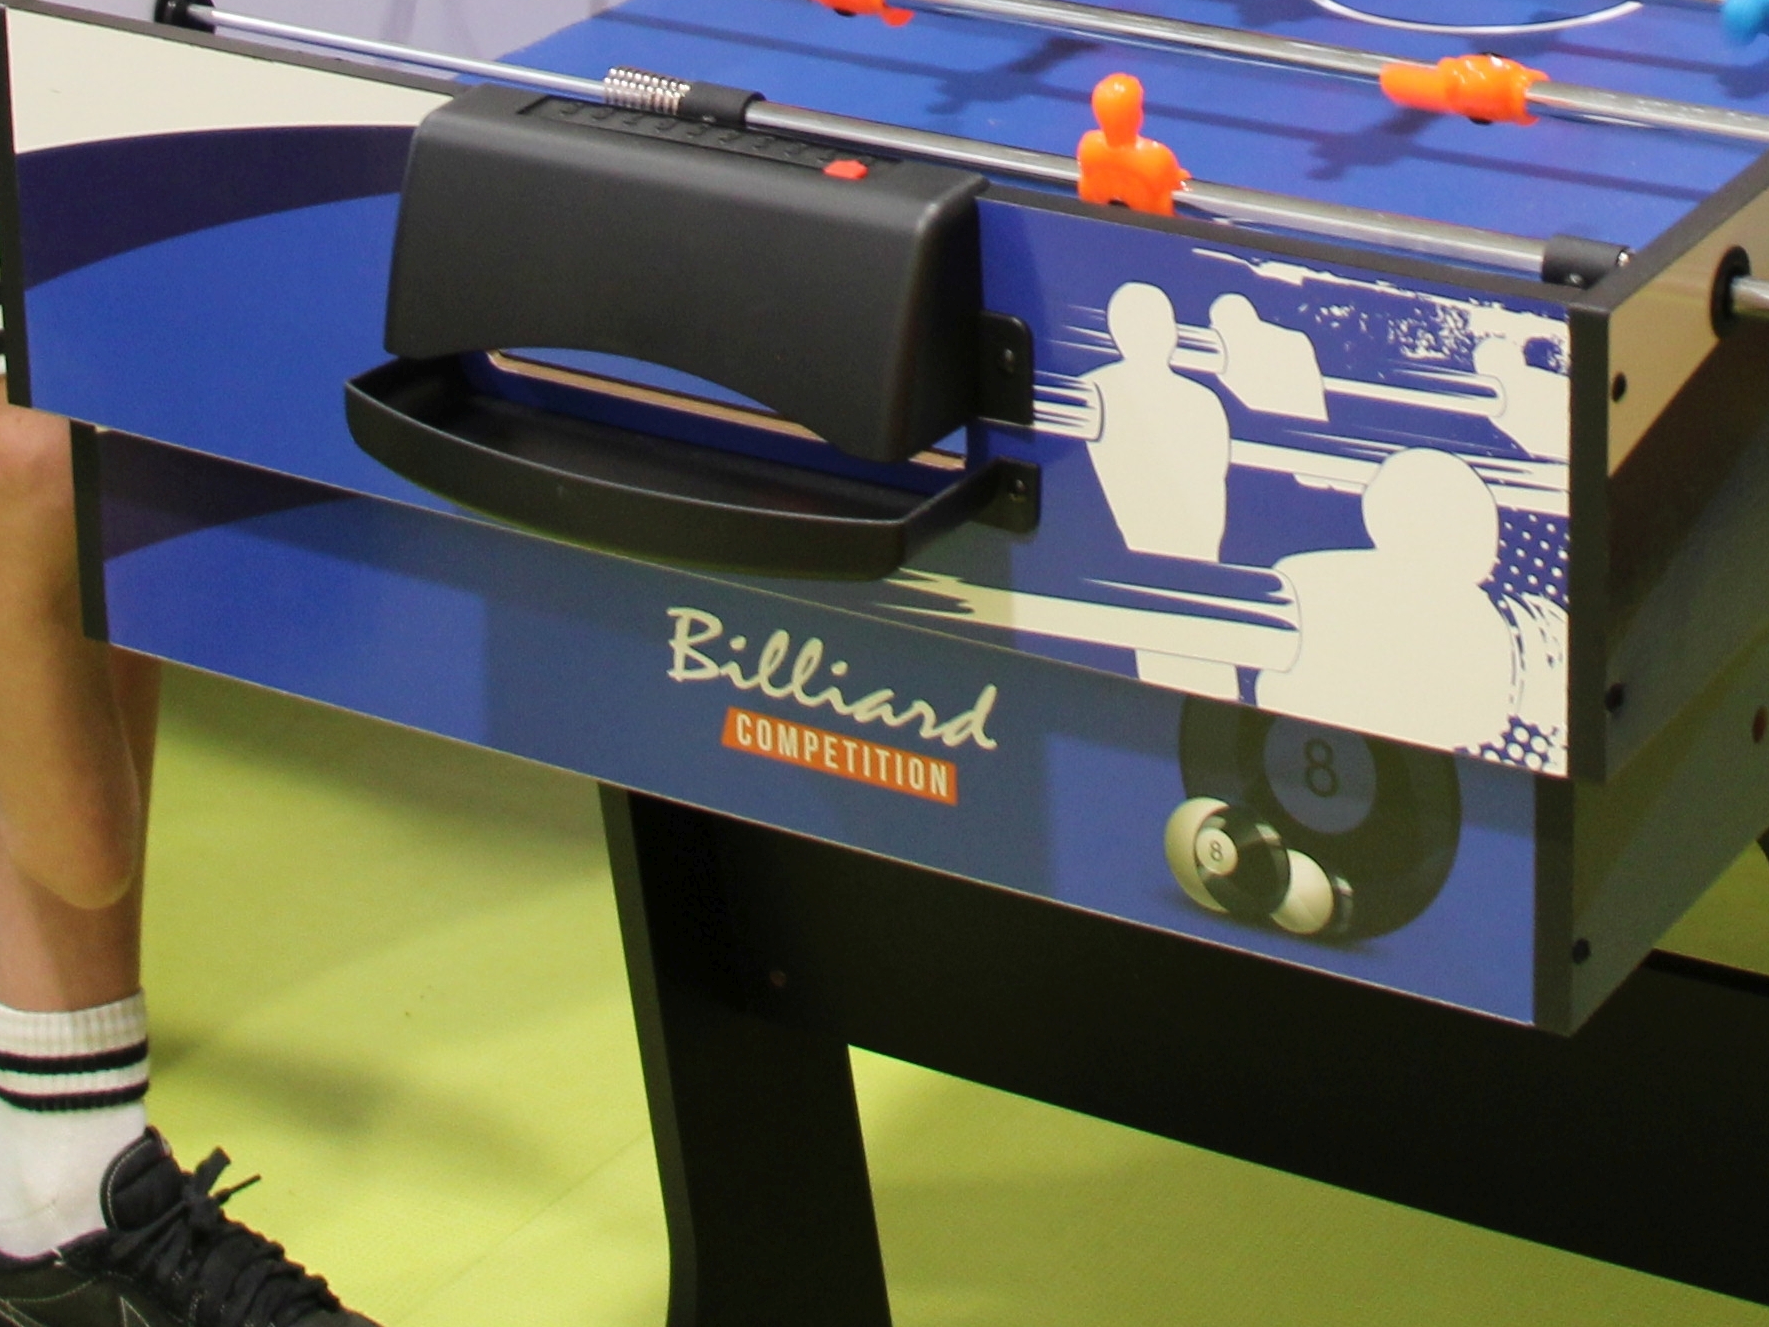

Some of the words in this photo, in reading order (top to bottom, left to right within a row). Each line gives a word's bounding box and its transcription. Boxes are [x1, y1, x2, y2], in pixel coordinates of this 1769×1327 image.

[666, 605, 998, 750] Billiard
[734, 712, 950, 798] COMPETITION
[1302, 737, 1341, 798] 8
